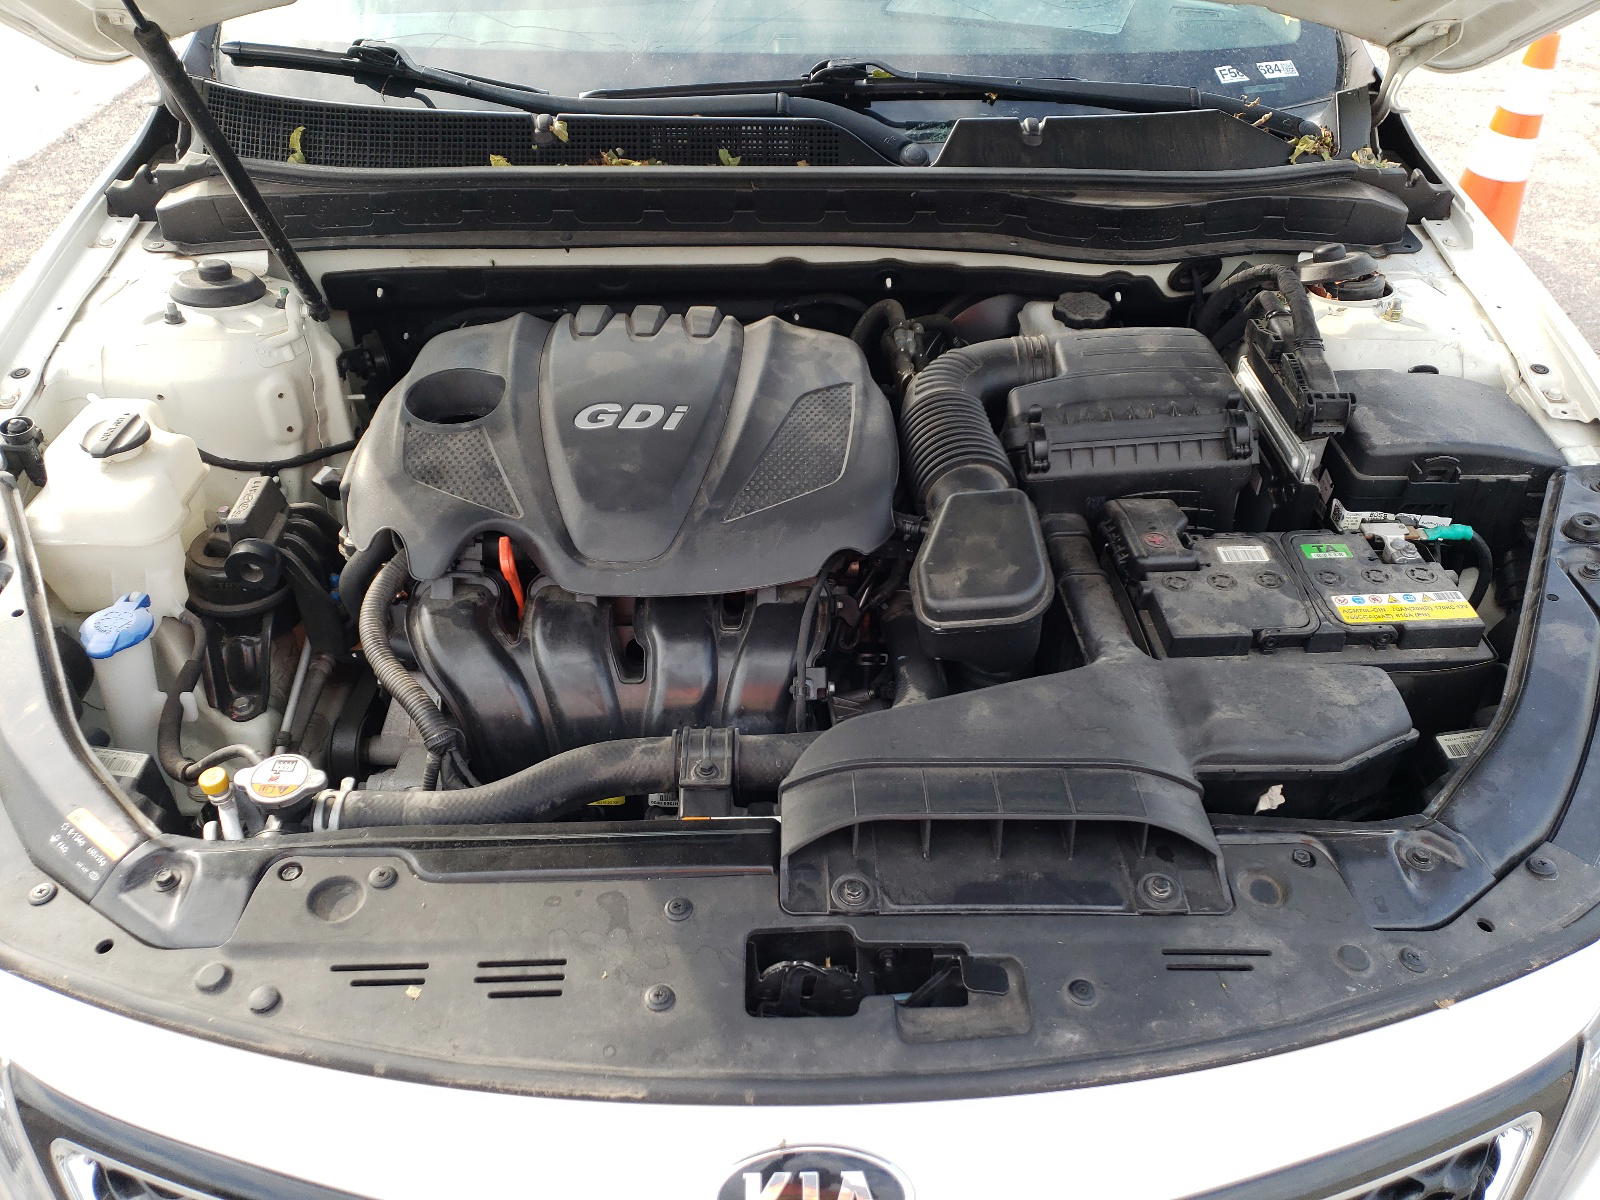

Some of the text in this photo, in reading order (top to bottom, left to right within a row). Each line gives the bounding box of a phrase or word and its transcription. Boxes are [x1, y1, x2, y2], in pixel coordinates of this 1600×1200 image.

[574, 403, 689, 431] GDi
[1311, 544, 1338, 553] TA
[742, 1170, 876, 1200] KIA
